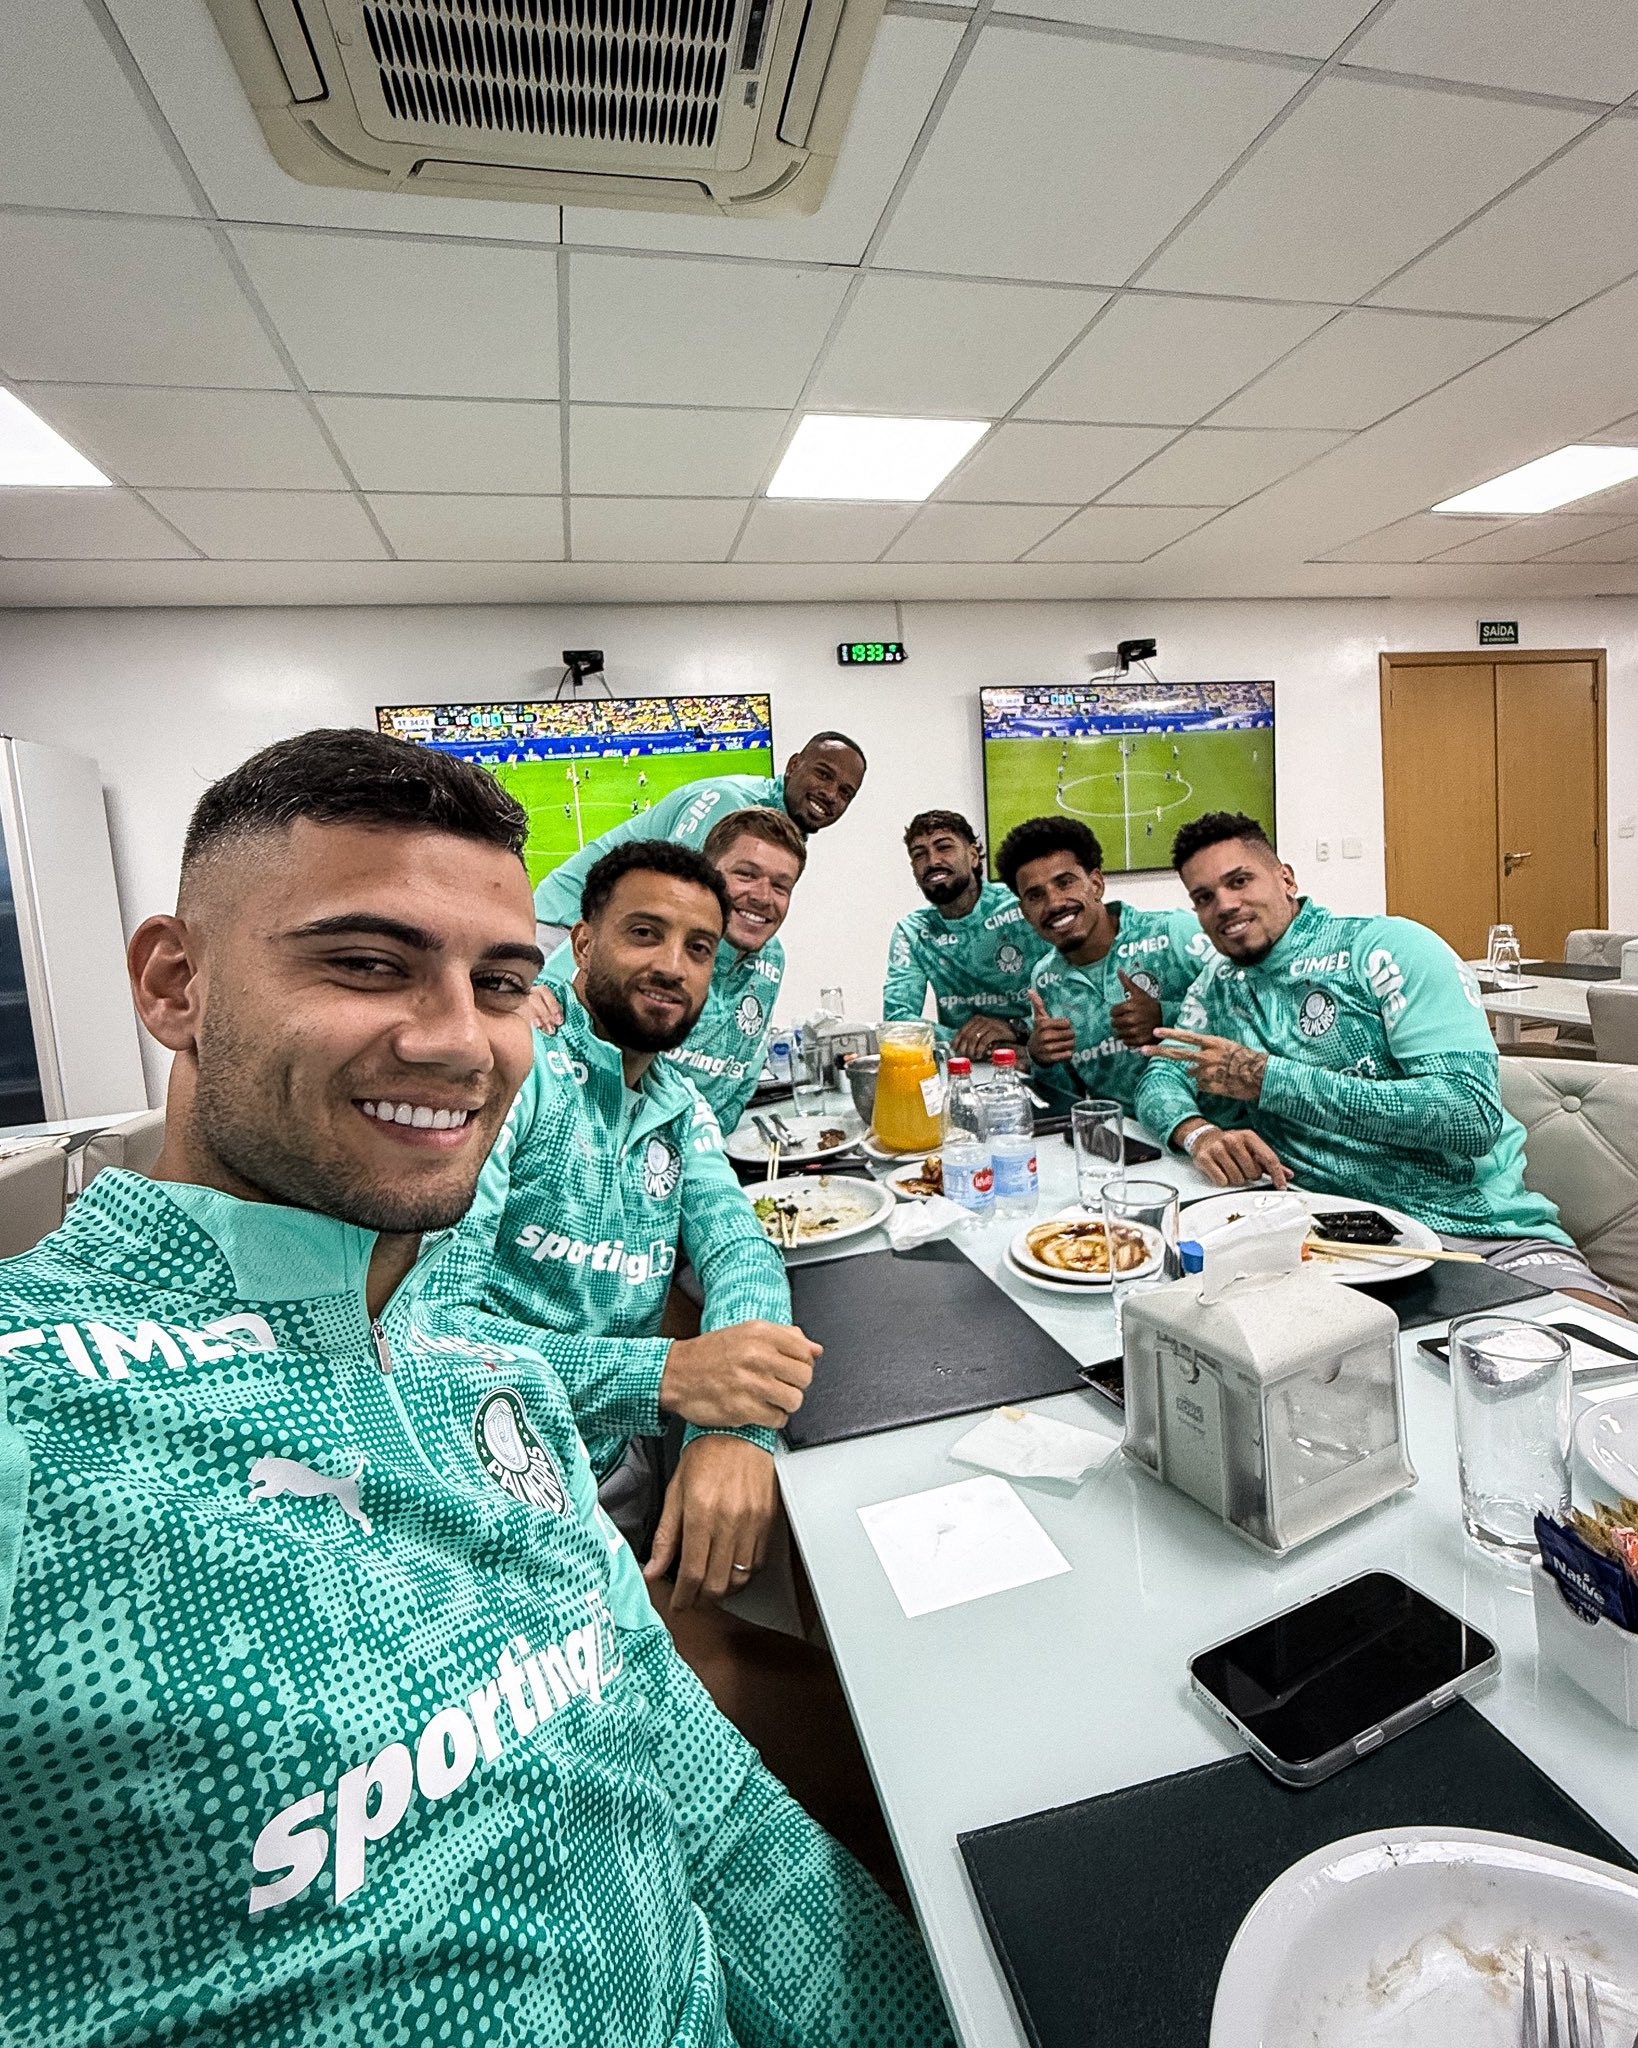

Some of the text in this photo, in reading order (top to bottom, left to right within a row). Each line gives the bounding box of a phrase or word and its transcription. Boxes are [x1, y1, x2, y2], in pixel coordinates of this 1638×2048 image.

[1483, 623, 1515, 637] SAÍDA
[1118, 935, 1169, 958] CIMED
[1289, 951, 1350, 977] CIMED
[1553, 1556, 1606, 1605] Native
